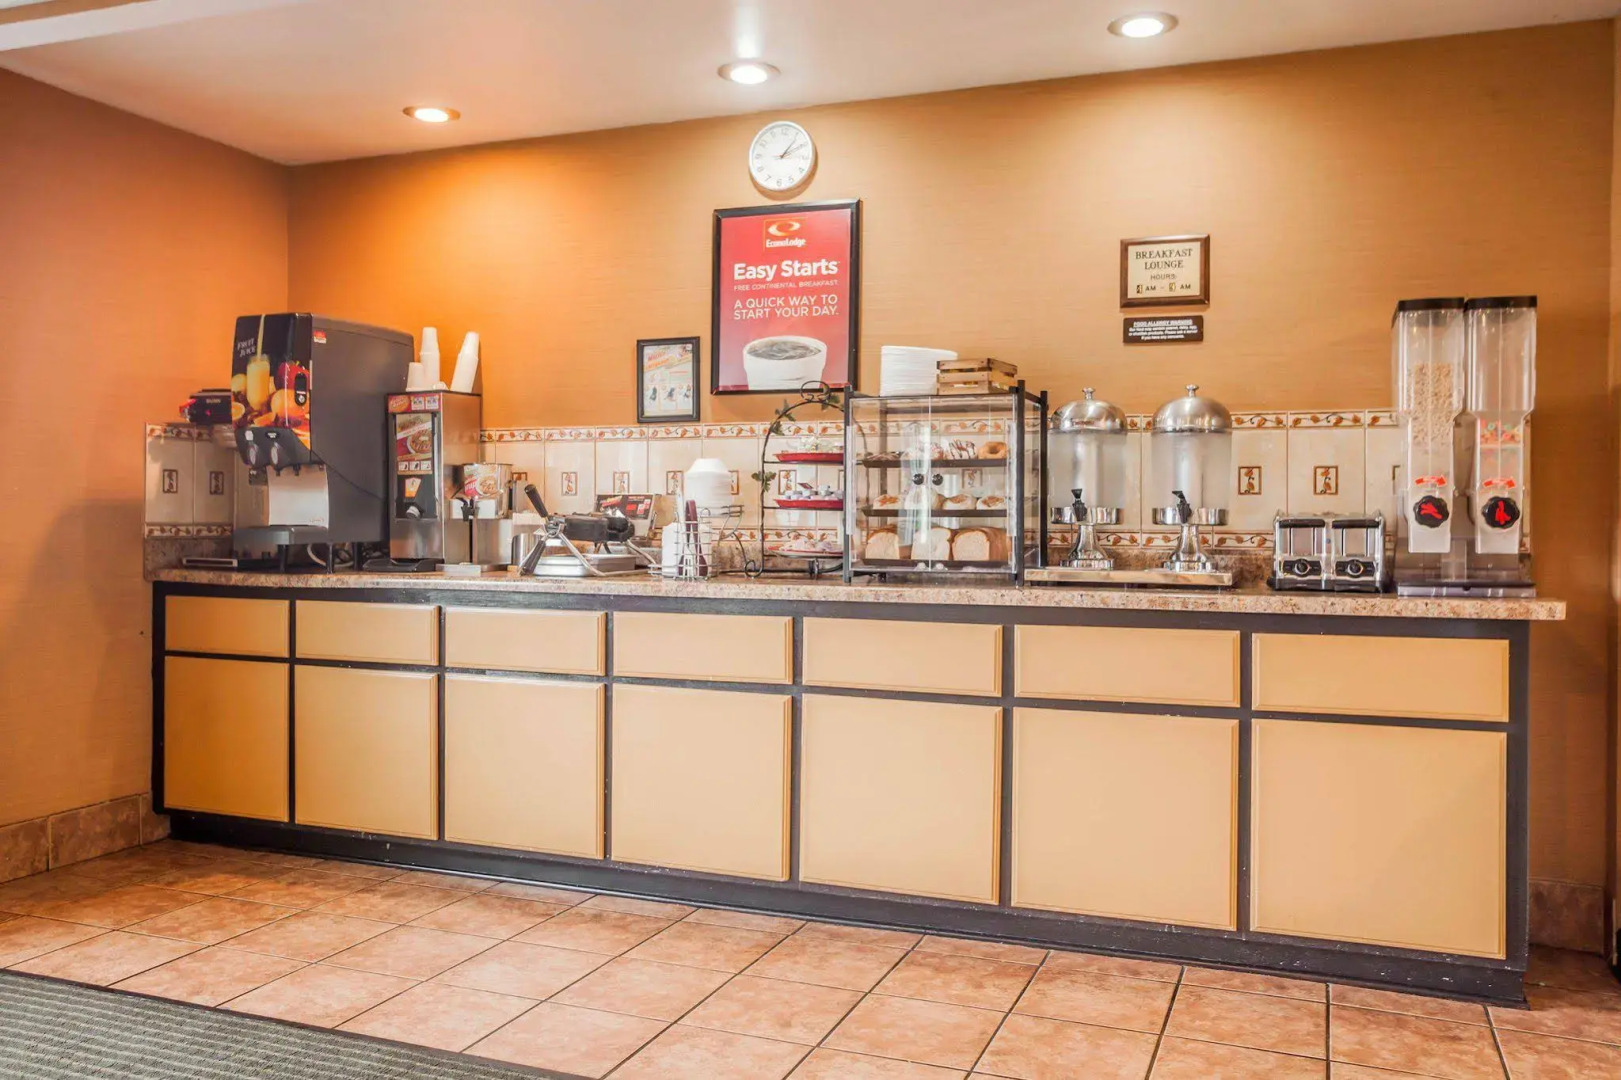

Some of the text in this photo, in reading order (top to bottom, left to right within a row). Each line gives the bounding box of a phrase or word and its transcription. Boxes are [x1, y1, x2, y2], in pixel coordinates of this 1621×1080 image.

[1135, 248, 1193, 260] BREAKFAST
[734, 258, 838, 281] Easy Starts
[1144, 260, 1184, 270] LOUNGE
[752, 280, 796, 290] CONTINENTAL
[734, 294, 838, 309] A QUICK WAY TO
[734, 305, 839, 320] START YOUR DAY.
